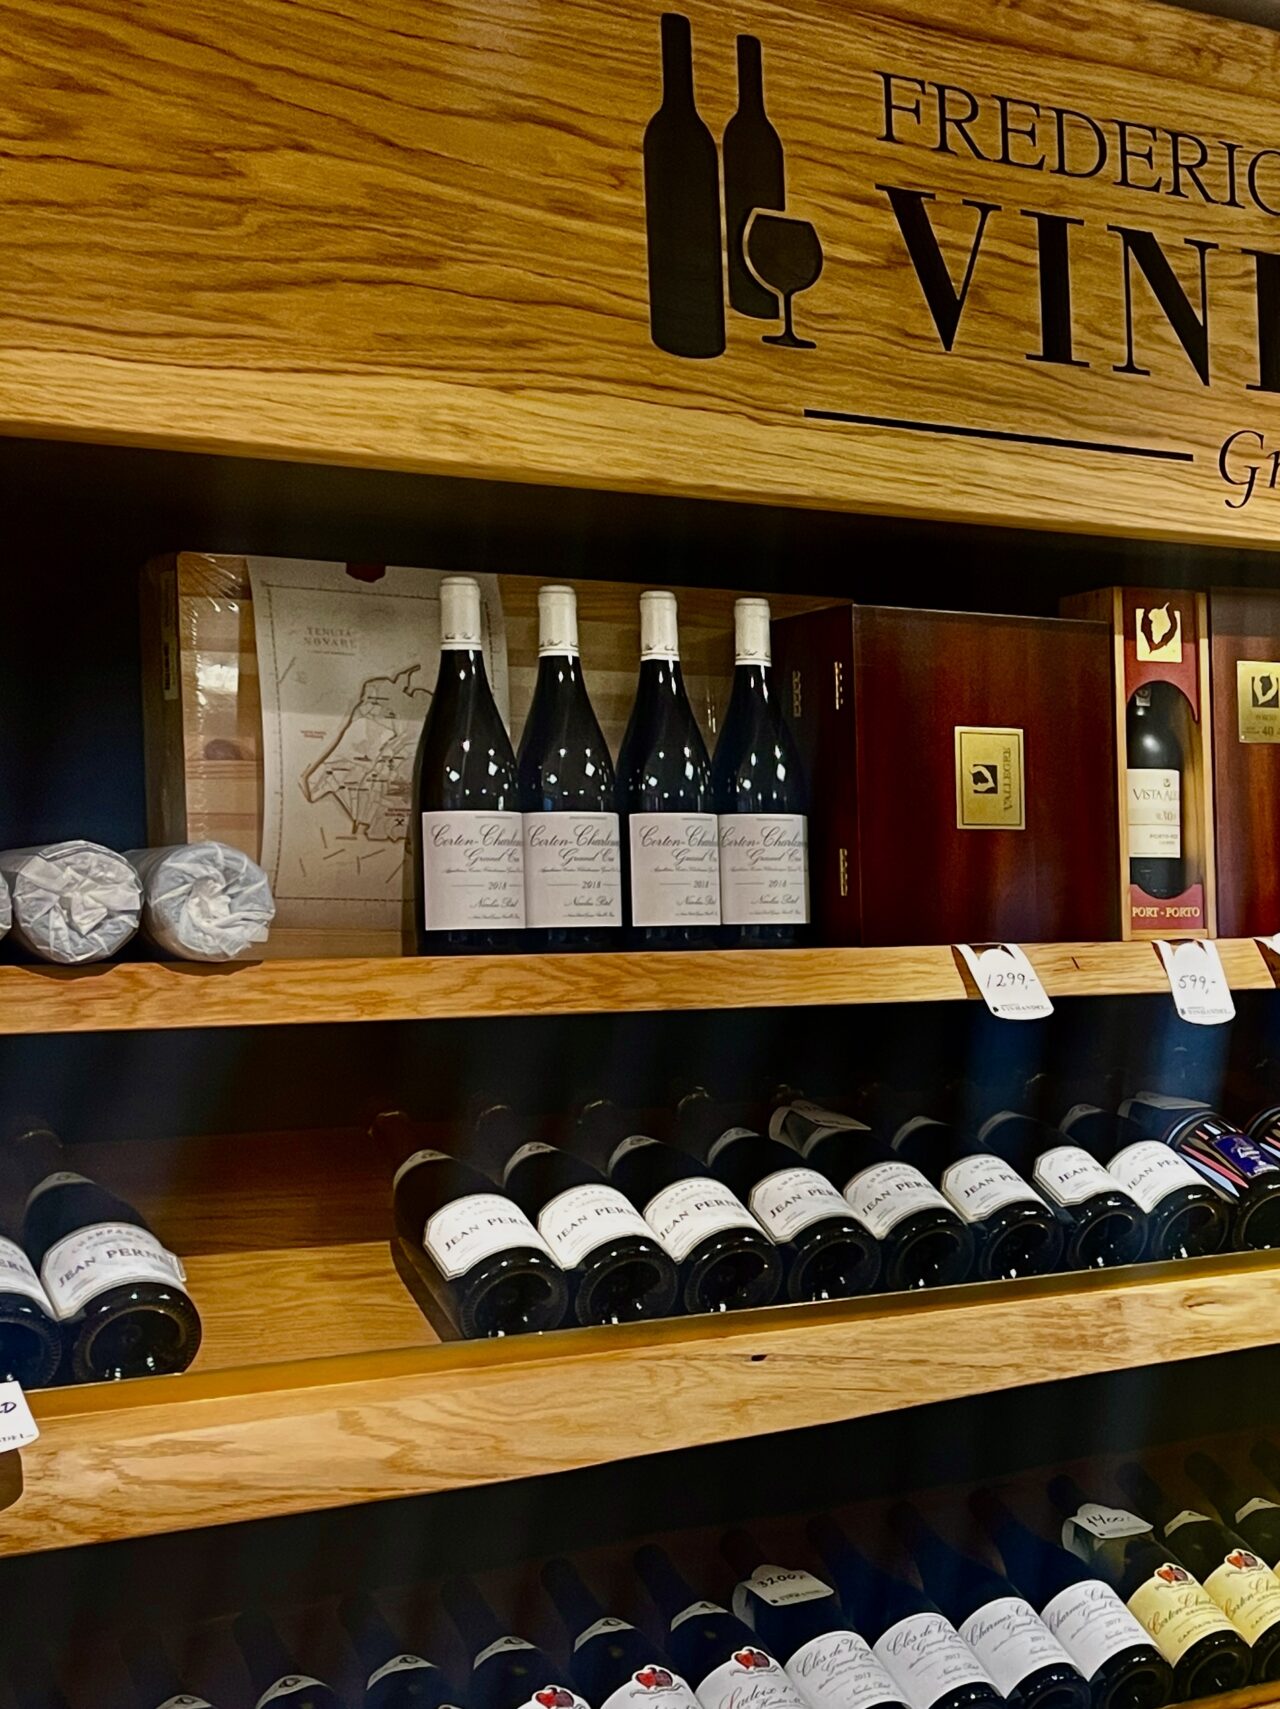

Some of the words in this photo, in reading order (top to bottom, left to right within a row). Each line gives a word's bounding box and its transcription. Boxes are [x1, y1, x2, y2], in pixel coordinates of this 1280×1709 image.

[1133, 788, 1162, 801] VISTA
[1132, 906, 1158, 917] PORT
[1166, 907, 1200, 918] PORTO
[964, 1176, 994, 1198] JEAN
[1058, 1166, 1089, 1183] JEAN
[769, 1194, 802, 1219] JEAN
[862, 1190, 892, 1216] JEAN
[444, 1223, 480, 1251] JEAN
[556, 1214, 588, 1242] JEAN
[659, 1210, 689, 1240] JEAN
[57, 1256, 97, 1288] JEAN
